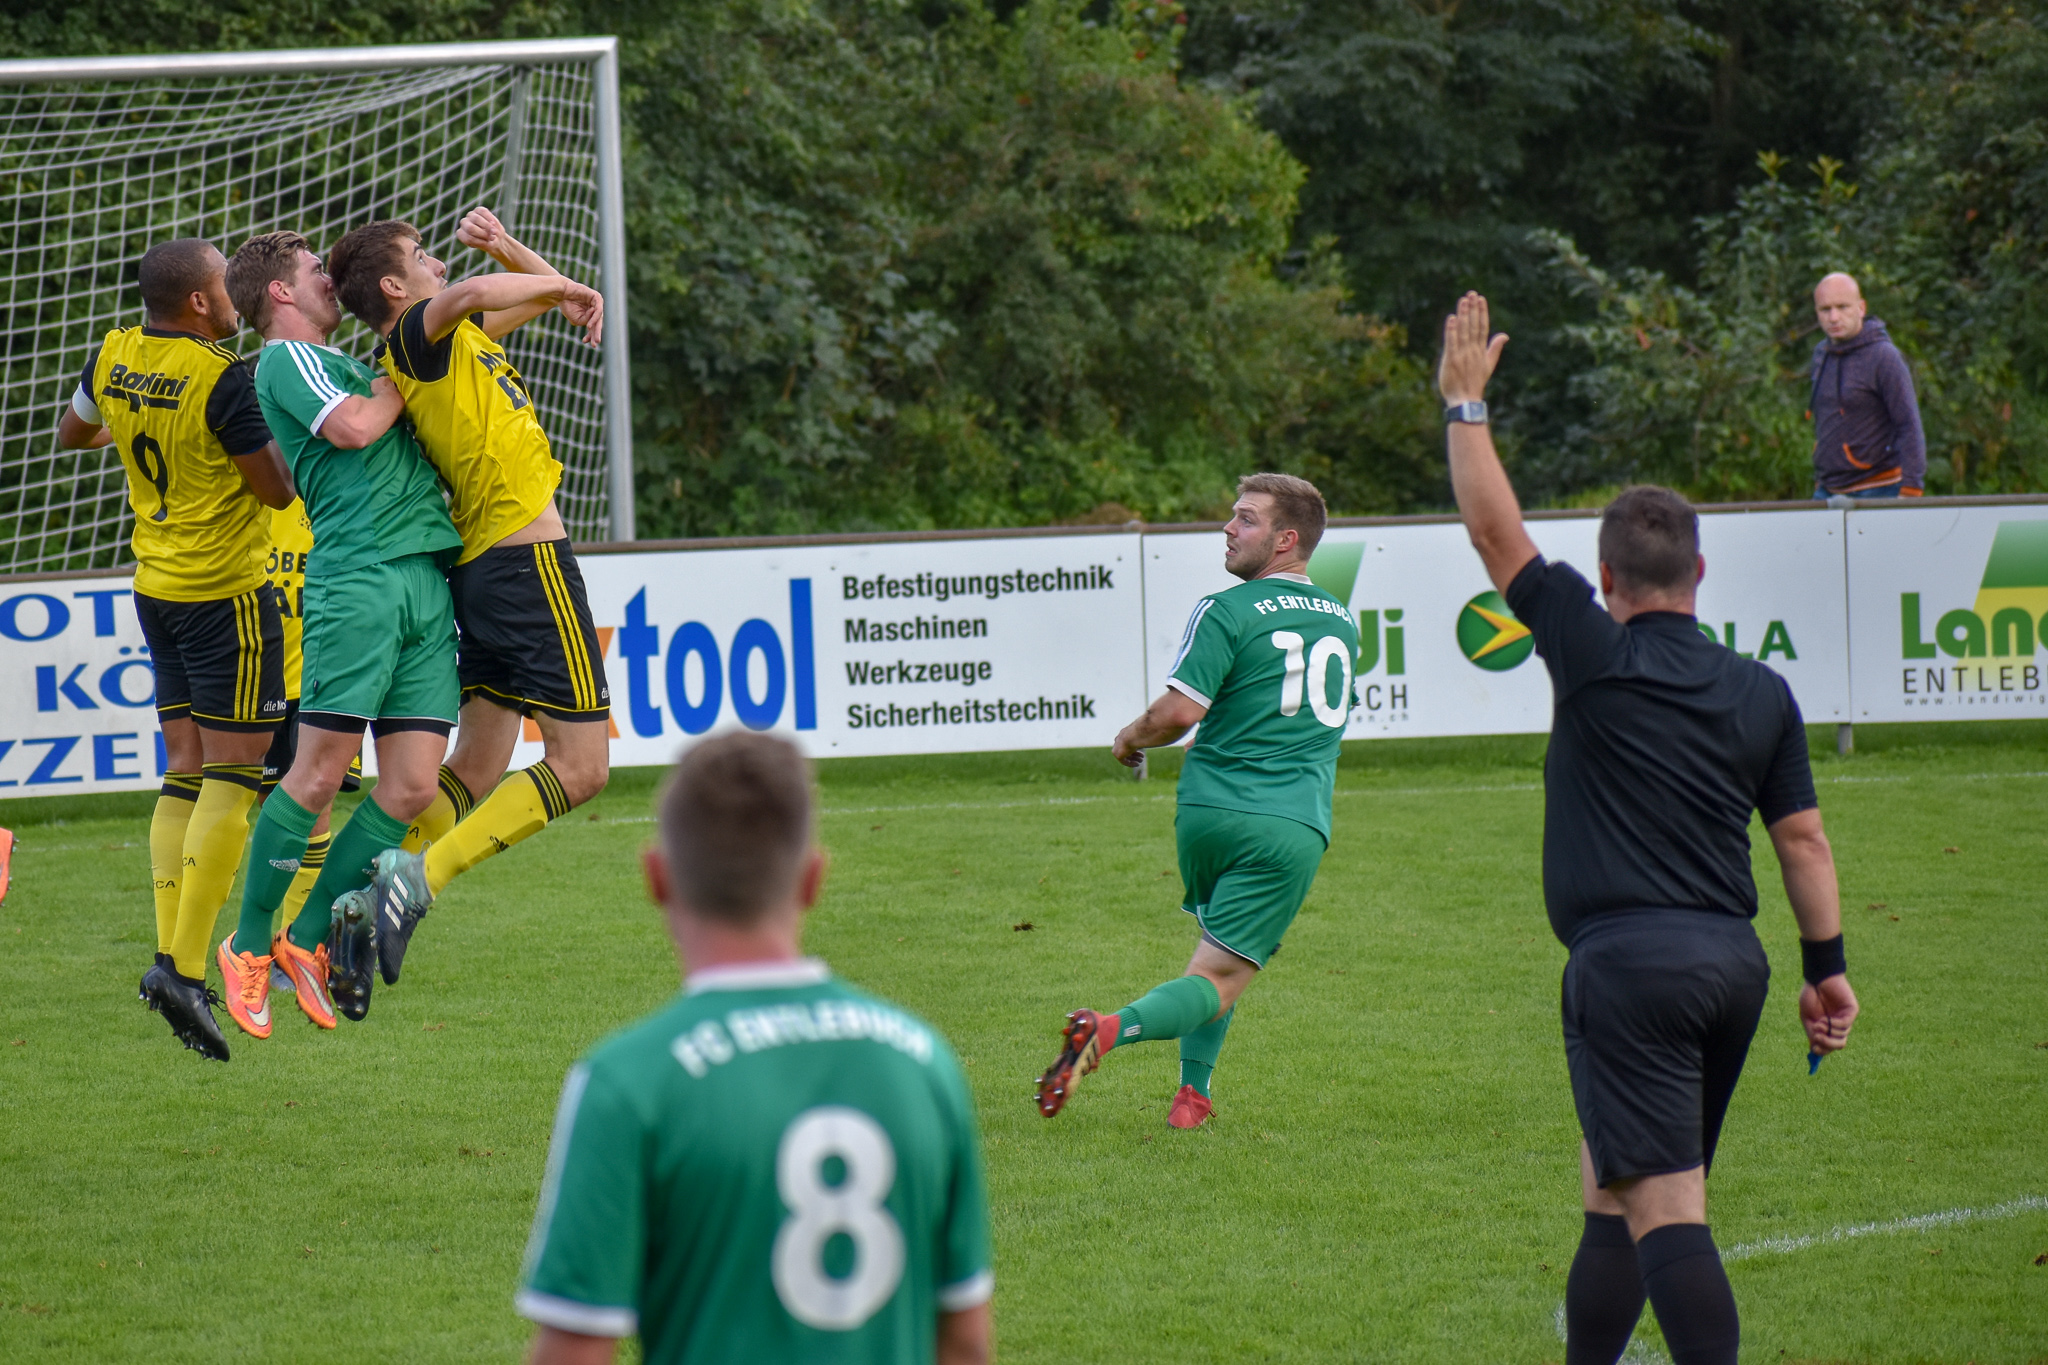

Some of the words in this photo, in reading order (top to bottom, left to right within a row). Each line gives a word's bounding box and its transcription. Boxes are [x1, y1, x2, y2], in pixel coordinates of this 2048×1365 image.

[131, 431, 168, 522] 9
[842, 565, 1115, 601] Befestigungstechnik
[844, 614, 988, 643] Maschinen
[1253, 599, 1278, 615] FC
[1901, 592, 2048, 660] Lan
[845, 659, 993, 686] Werkzeuge
[1271, 630, 1353, 728] 10
[847, 694, 1097, 728] Sicherheitstechnik
[670, 1020, 736, 1079] FC
[771, 1104, 907, 1331] 8
